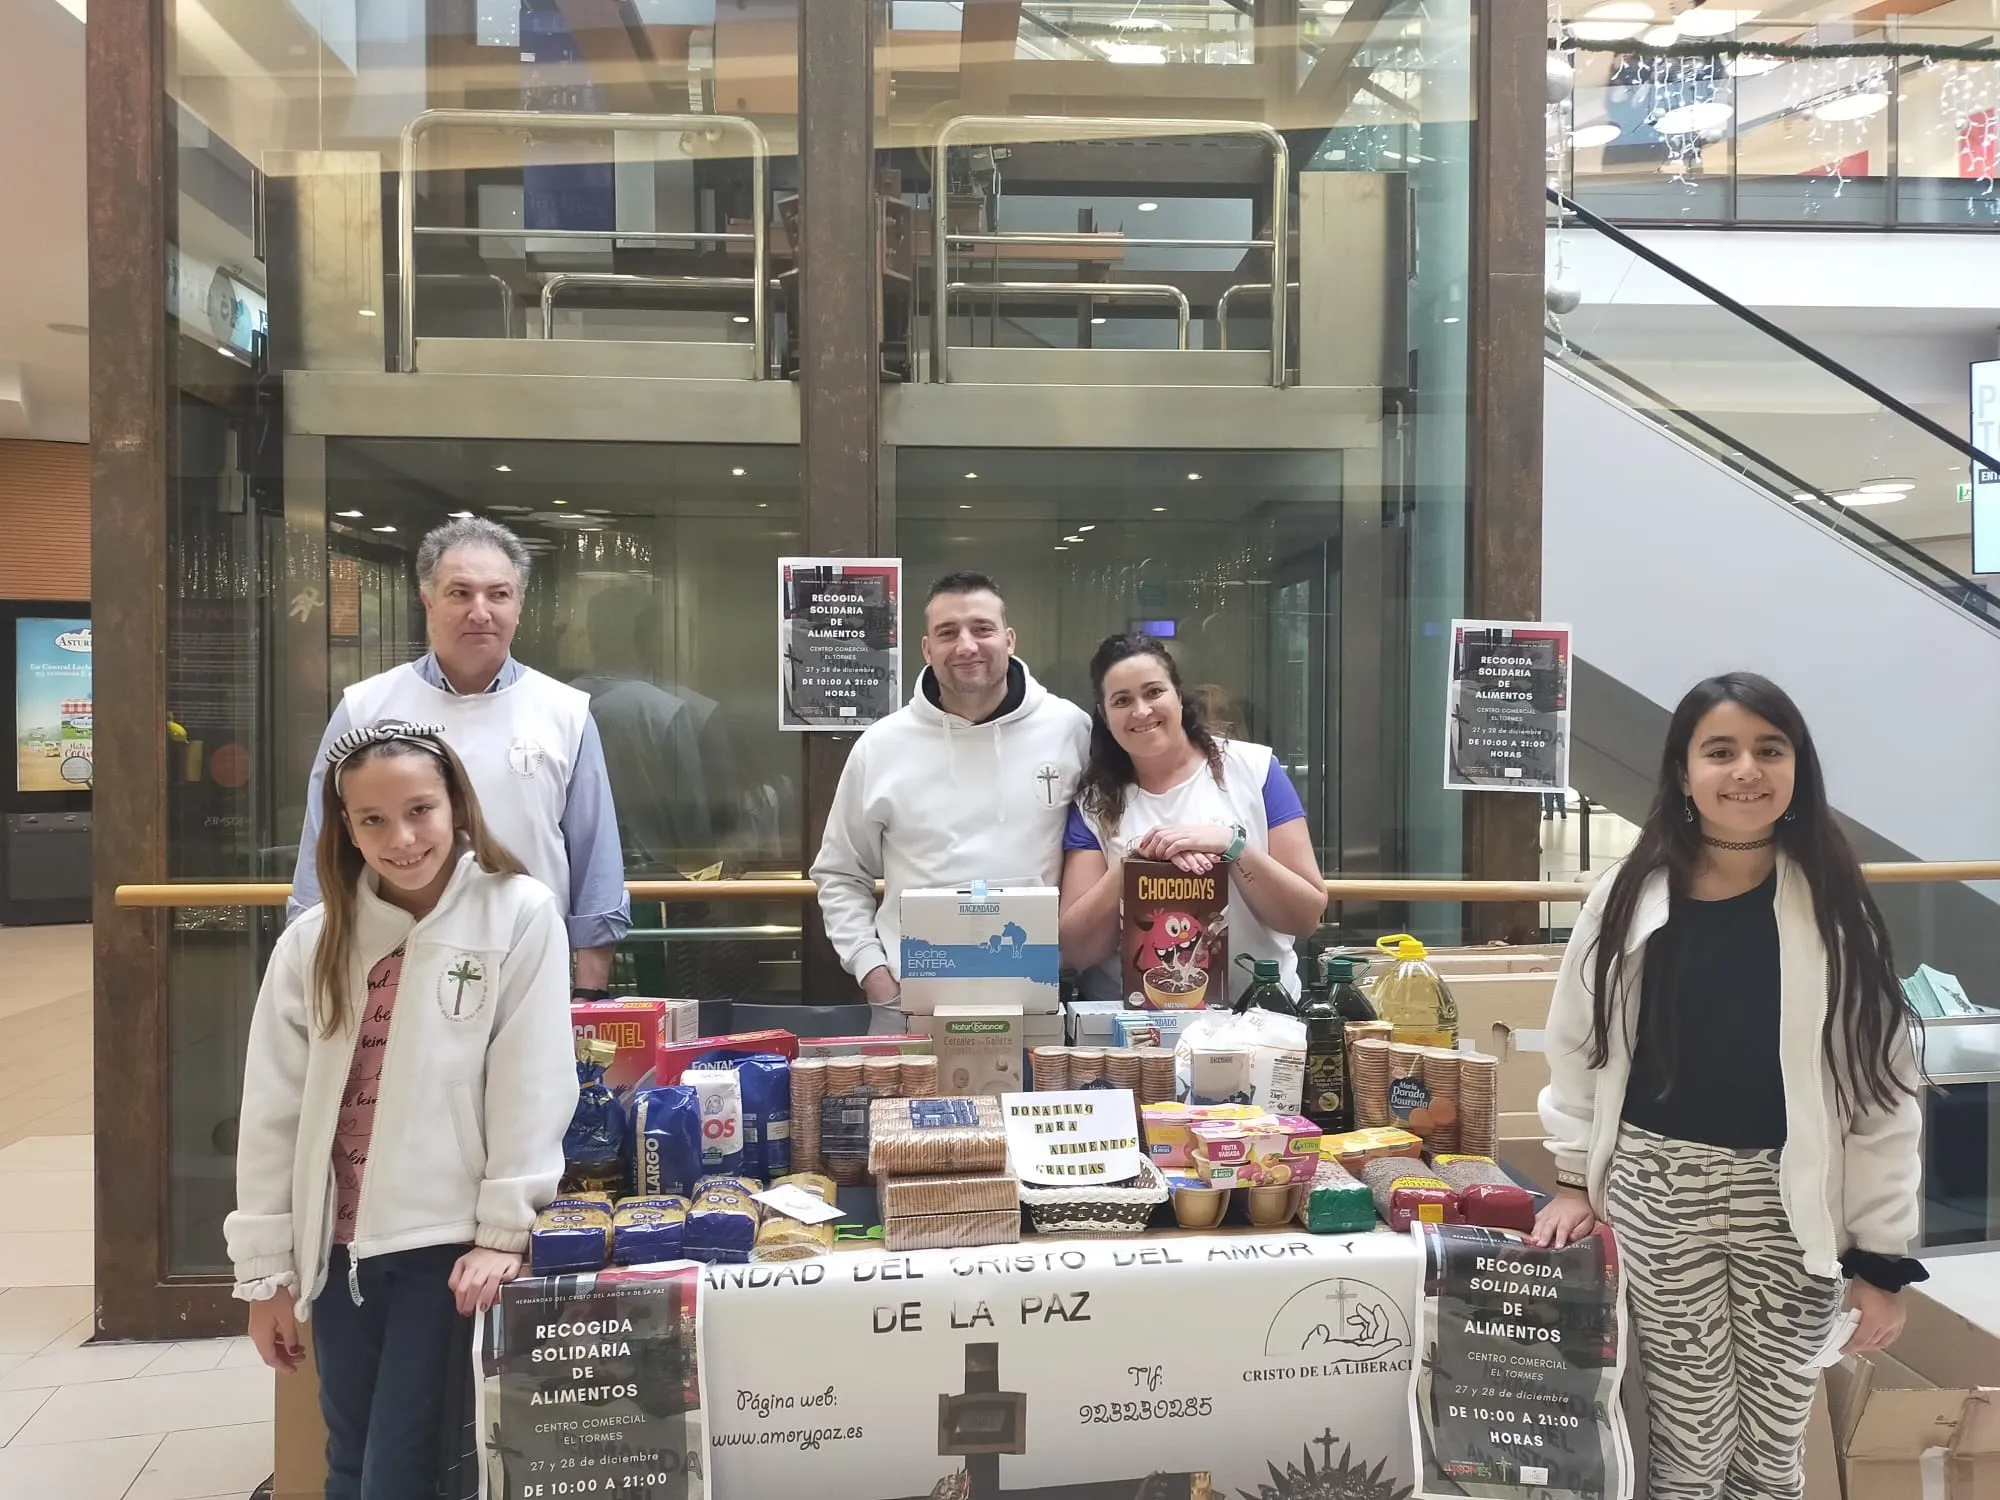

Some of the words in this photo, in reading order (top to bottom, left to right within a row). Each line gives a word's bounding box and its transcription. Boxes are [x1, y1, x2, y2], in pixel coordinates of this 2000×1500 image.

[812, 594, 864, 602] RECOGIDA
[810, 606, 863, 614] SOLIDARIA
[830, 618, 843, 626] DE
[808, 630, 866, 638] ALIMENTOS
[1481, 656, 1533, 666] RECOGIDA
[1478, 668, 1531, 677] SOLIDARIA
[1498, 680, 1510, 688] DE
[1475, 691, 1533, 700] ALIMENTOS
[1508, 727, 1542, 735] diciembre
[1521, 740, 1545, 748] 21:00
[1138, 875, 1215, 900] CHOCODAYS
[959, 904, 1000, 913] HACENDADO
[908, 949, 947, 959] Leche
[908, 959, 956, 968] ENTERA
[600, 1022, 646, 1049] MIEL
[1393, 1086, 1425, 1099] Dorada
[1391, 1095, 1428, 1108] Dourada
[1011, 1104, 1094, 1116] DONATIVO
[1035, 1121, 1077, 1133] PARA
[1050, 1137, 1136, 1155] ALIMENTOS
[646, 1138, 661, 1195] LARGO
[1036, 1163, 1105, 1175] GRACIAS
[853, 1257, 924, 1282] DEL
[950, 1250, 1087, 1277] CRISTO
[1112, 1246, 1183, 1267] DEL
[1207, 1241, 1314, 1262] AMOR
[1339, 1241, 1355, 1254] Y
[1476, 1256, 1563, 1279] RECOGIDA
[1470, 1277, 1558, 1299] SOLIDARIA
[515, 1296, 553, 1305] HERMANDAD
[872, 1301, 923, 1334] DE
[950, 1295, 995, 1329] LA
[1020, 1291, 1092, 1325] PAZ
[1503, 1302, 1523, 1317] DE
[536, 1318, 633, 1340] RECOGIDA
[1464, 1320, 1561, 1343] ALIMENTOS
[531, 1342, 631, 1363] SOLIDARIA
[1467, 1352, 1507, 1364] CENTRO
[1510, 1356, 1567, 1370] COMERCIAL
[572, 1367, 594, 1380] DE
[1128, 1365, 1163, 1392] Tlf:
[1243, 1368, 1296, 1382] CRISTO
[1300, 1366, 1319, 1378] DE
[1323, 1364, 1341, 1376] LA
[1490, 1368, 1501, 1377] EL
[1505, 1369, 1544, 1381] TORMES
[530, 1383, 638, 1406] ALIMENTOS
[736, 1389, 794, 1418] Página
[800, 1386, 837, 1408] web:
[1455, 1385, 1468, 1394] 27
[1472, 1387, 1478, 1397] y
[1482, 1387, 1495, 1397] 28
[1499, 1389, 1513, 1398] de
[1516, 1390, 1569, 1403] diciembre
[1079, 1397, 1213, 1424] 923230285
[1449, 1405, 1468, 1418] DE
[1473, 1408, 1515, 1423] 10:00
[1522, 1413, 1533, 1424] A
[1539, 1414, 1579, 1428] 21:00
[534, 1421, 579, 1434] CENTRO
[582, 1414, 647, 1429] COMERCIAL
[563, 1436, 577, 1446] EL
[579, 1432, 623, 1444] TORMES
[712, 1426, 864, 1451] www.amorypaz.es
[1490, 1431, 1544, 1447] HORAS
[530, 1460, 545, 1472] 27
[549, 1461, 557, 1473] y
[560, 1458, 576, 1469] 28
[580, 1455, 595, 1467] de
[599, 1452, 660, 1466] diciembre
[523, 1484, 544, 1498] DE
[551, 1480, 598, 1496] 10:00
[604, 1477, 617, 1490] A
[623, 1472, 668, 1490] 21:00
